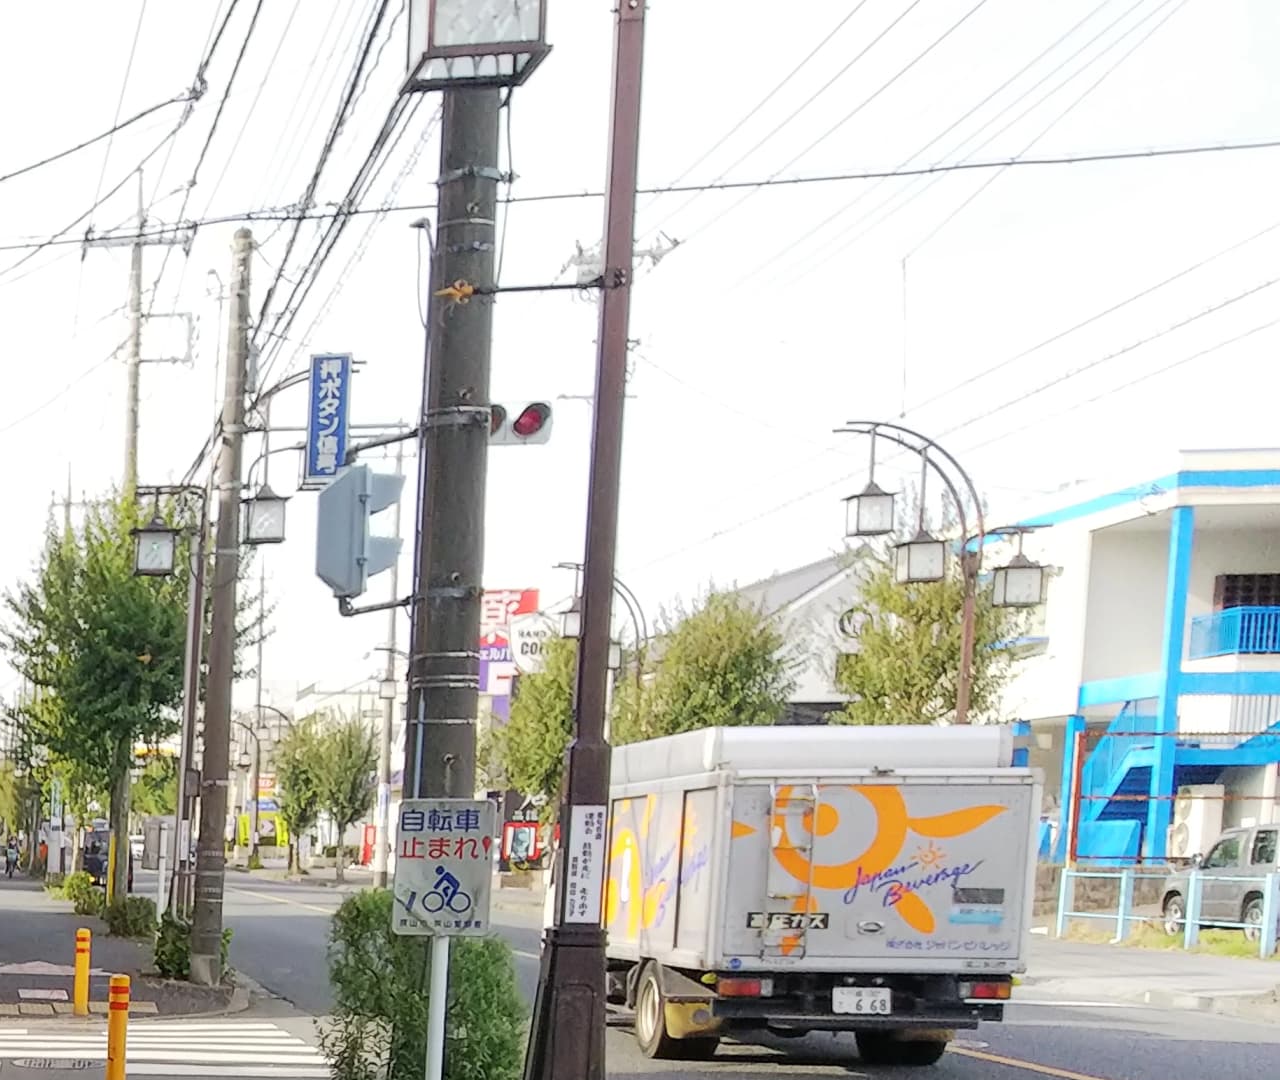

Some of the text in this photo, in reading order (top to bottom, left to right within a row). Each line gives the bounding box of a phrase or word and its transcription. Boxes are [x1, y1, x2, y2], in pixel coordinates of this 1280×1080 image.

[316, 359, 343, 474] 押ボタン信号
[401, 809, 480, 833] 自転車
